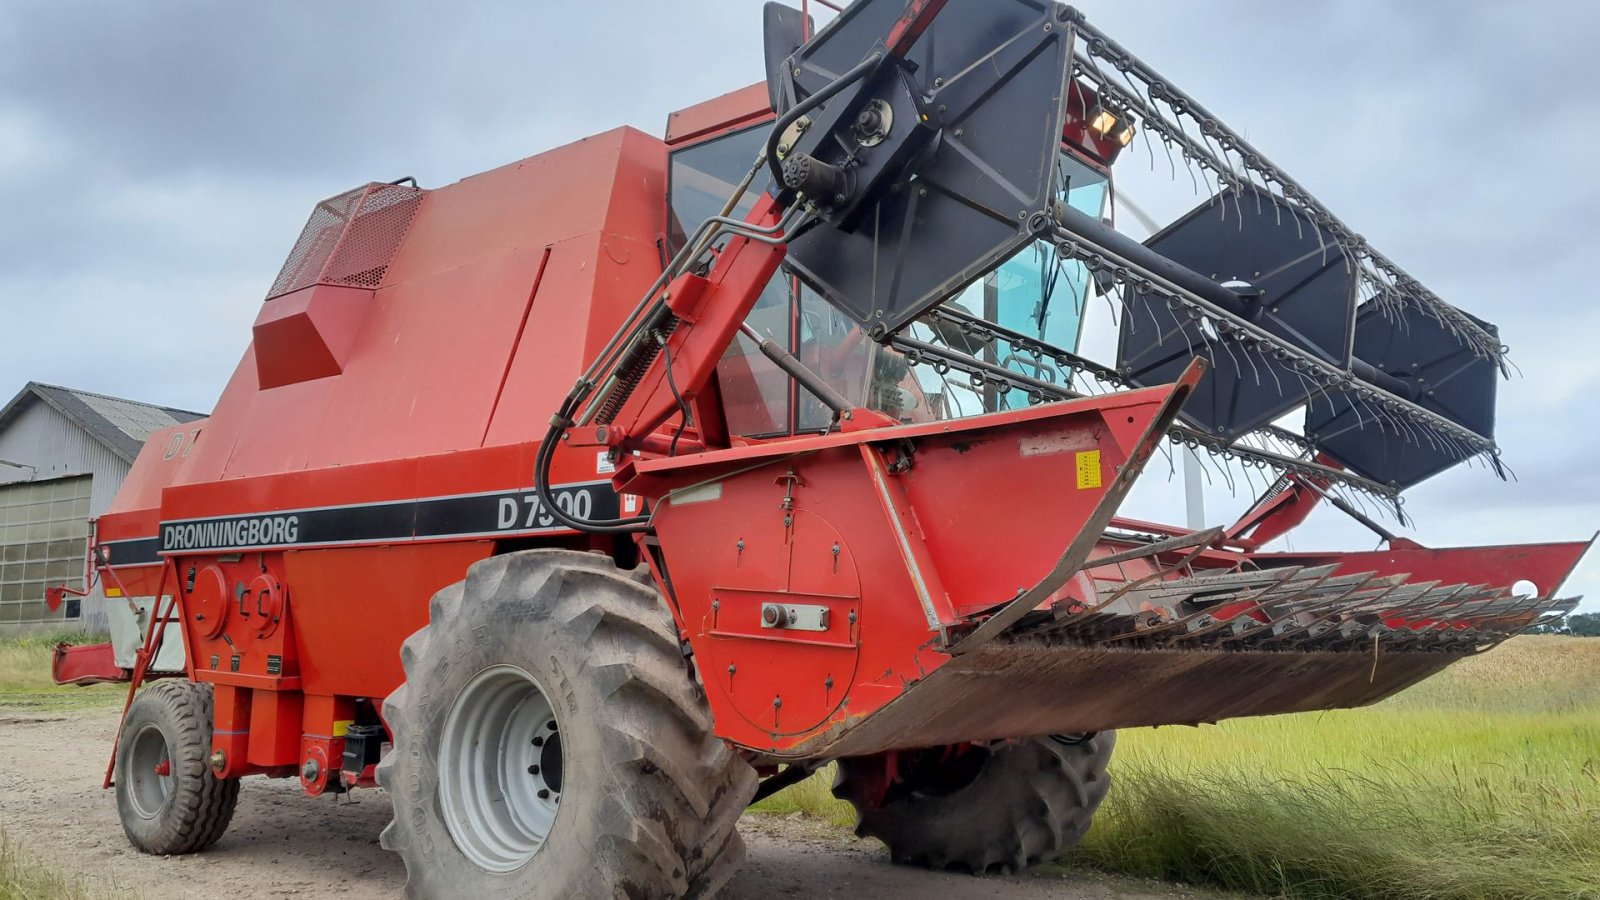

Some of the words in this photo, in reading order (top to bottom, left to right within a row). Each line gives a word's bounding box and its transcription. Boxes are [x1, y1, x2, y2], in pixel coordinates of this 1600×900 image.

[164, 433, 183, 460] D
[497, 497, 518, 529] D
[164, 516, 299, 549] DRONNINGBORG
